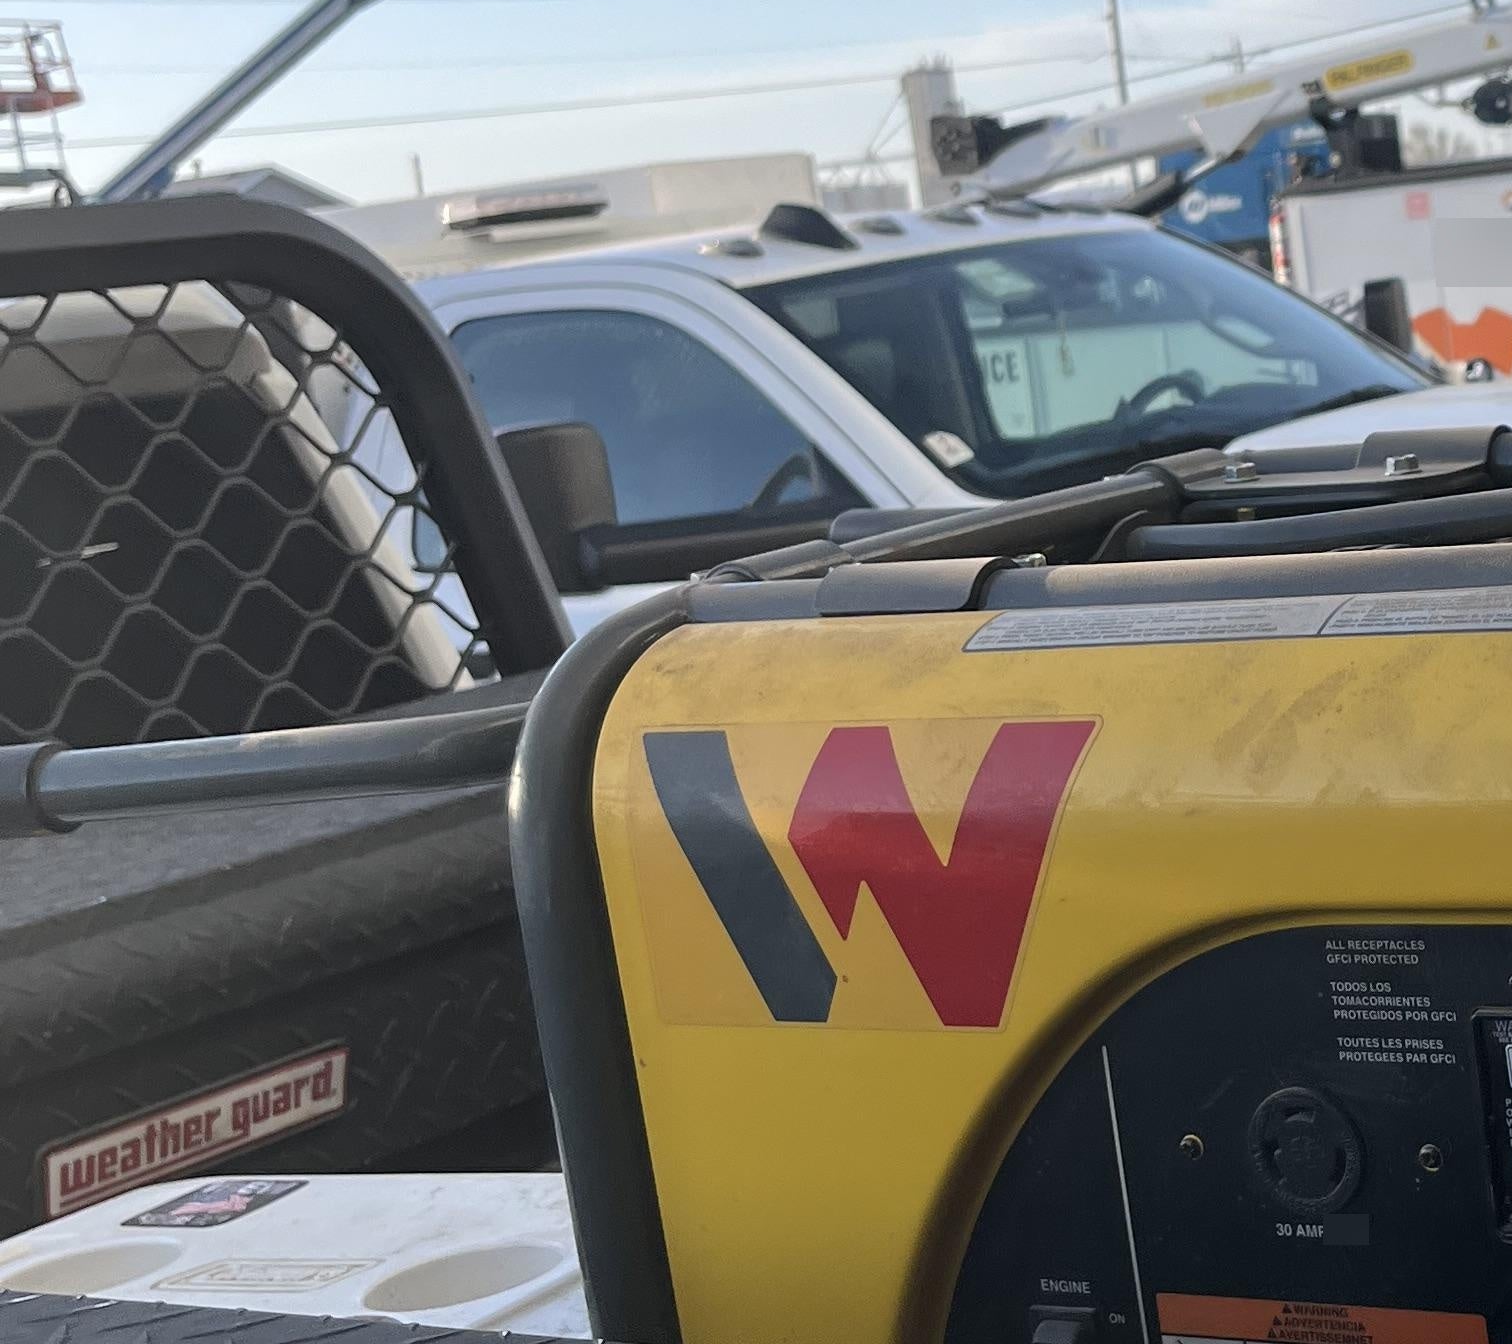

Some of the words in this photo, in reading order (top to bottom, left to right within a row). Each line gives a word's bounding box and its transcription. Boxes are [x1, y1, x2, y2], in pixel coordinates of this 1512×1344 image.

[643, 721, 1096, 1027] W
[1325, 940, 1345, 950] ALL
[1348, 940, 1425, 950] RECEPTACLES
[1326, 954, 1351, 964] GFCI
[1354, 954, 1419, 964] PROTECTED
[1330, 981, 1367, 992] TODOS
[1370, 982, 1391, 992] LOS
[1331, 996, 1430, 1007] TOMACORRIENTES
[1333, 1010, 1403, 1021] PROTEGIDOS
[1405, 1011, 1428, 1021] POR
[1431, 1012, 1456, 1022] GFCI
[1337, 1037, 1379, 1048] TOUTES
[1382, 1038, 1402, 1048] LES
[1405, 1039, 1444, 1049] PRISES
[1339, 1051, 1404, 1062] PROTEGEES
[1406, 1052, 1428, 1063] PAR
[1430, 1053, 1456, 1064] GFCI
[60, 1108, 221, 1196] weather
[232, 1060, 333, 1136] guard
[1275, 1223, 1293, 1236] 30
[1040, 1278, 1091, 1294] ENGINE
[1108, 1313, 1126, 1325] ON
